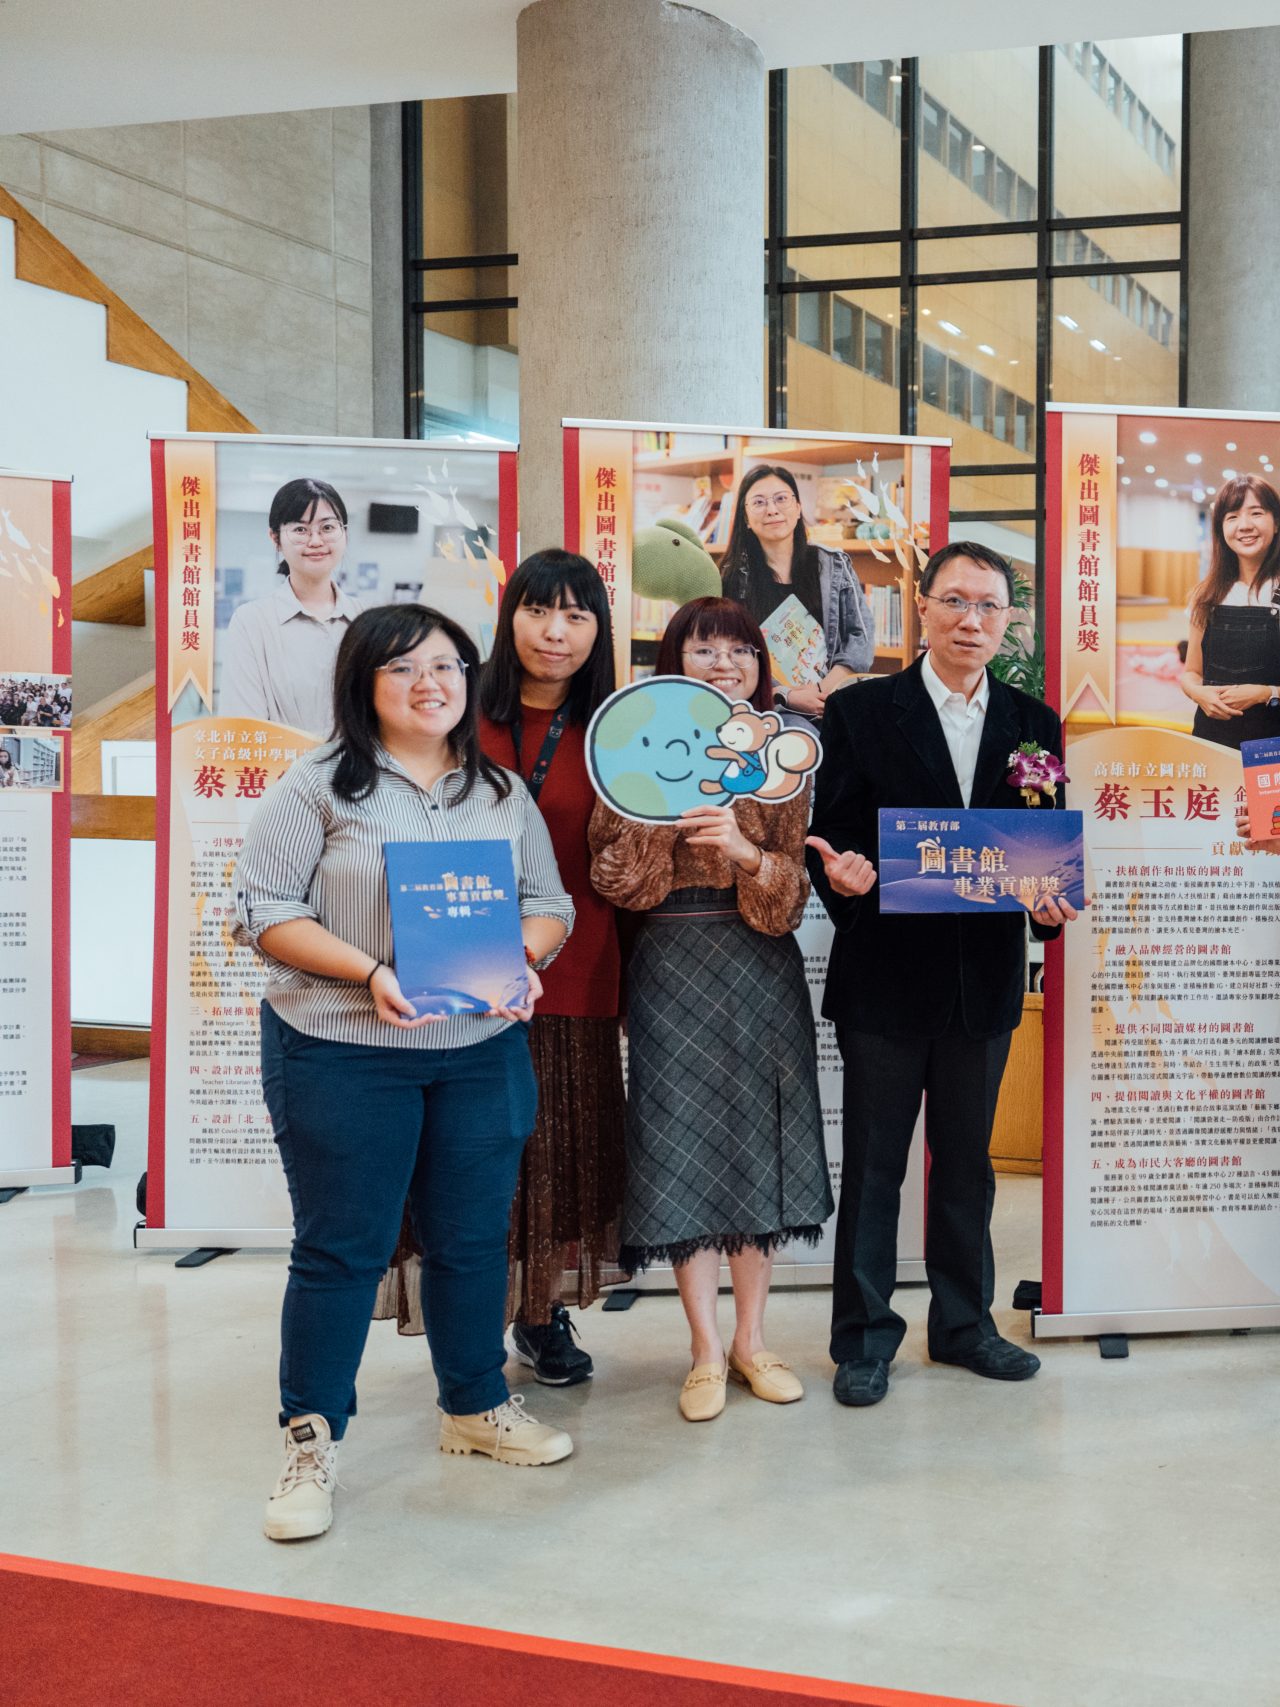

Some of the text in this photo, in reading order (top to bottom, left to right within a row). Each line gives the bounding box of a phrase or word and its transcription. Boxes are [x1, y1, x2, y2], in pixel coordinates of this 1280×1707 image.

[1077, 453, 1100, 653] 傑出圖書館館員獎
[181, 476, 201, 651] 傑出圖書館館員獎
[1094, 762, 1208, 778] 高雄市立圖書館
[193, 765, 286, 799] 蔡蕙
[1094, 783, 1221, 821] 蔡玉庭
[896, 820, 960, 832] 第二屆教育部
[916, 836, 1008, 874] 圖書館
[1092, 866, 1243, 877] 一、扶植創作和出版的圖書館
[953, 876, 1066, 898] 事業貢獻獎
[1092, 944, 1231, 955] 二、融入品牌經營的圖書館
[1092, 1023, 1254, 1034] 三、提供不同閱讀媒材的圖書館
[1091, 1089, 1265, 1102] 四、提倡閱讀與文化平權的圖書館
[1091, 1156, 1242, 1169] 五、成為市民大客廳的圖書館
